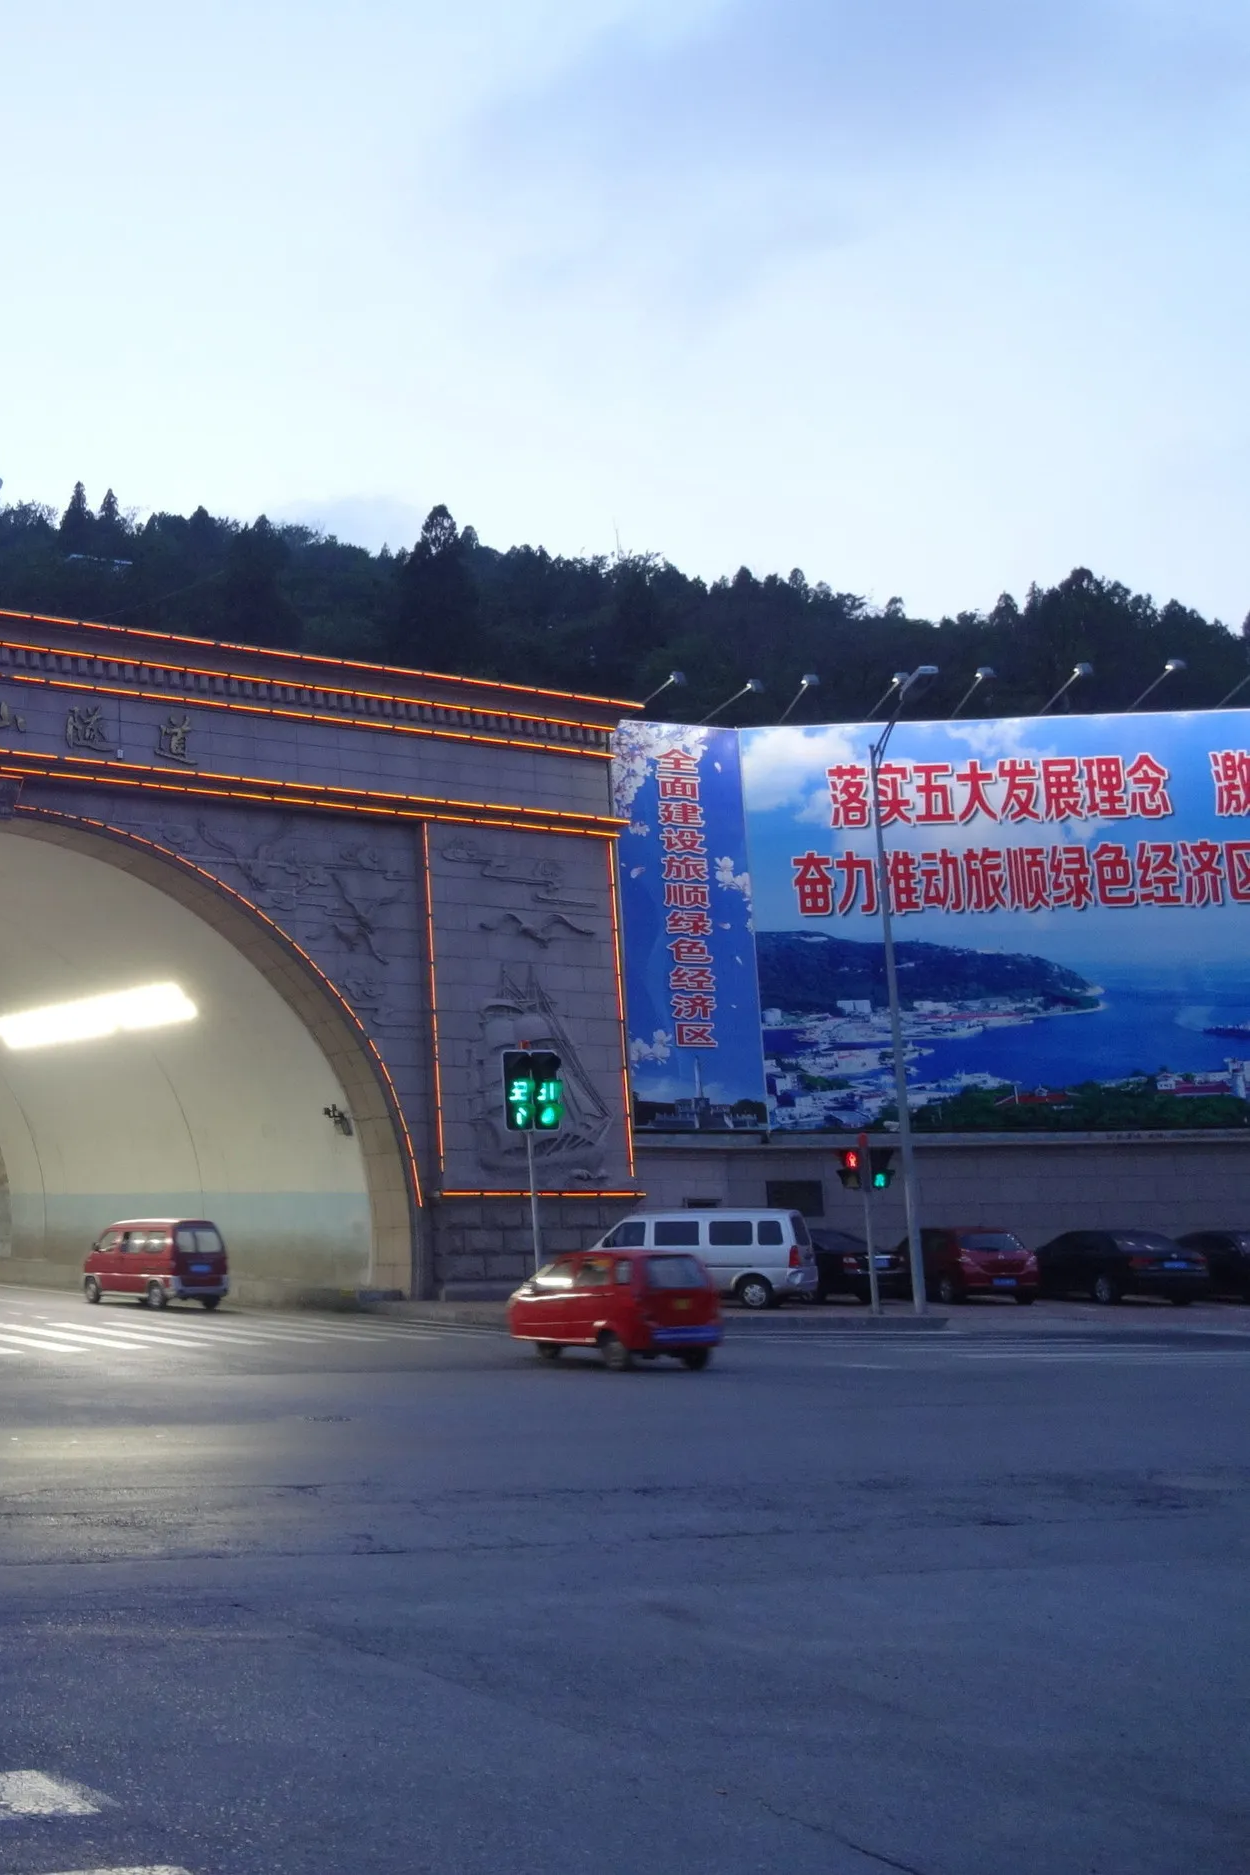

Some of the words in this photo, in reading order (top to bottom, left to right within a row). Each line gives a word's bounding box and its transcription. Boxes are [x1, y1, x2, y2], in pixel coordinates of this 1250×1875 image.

[827, 752, 1173, 828] 落实五大发展理念
[655, 748, 718, 1048] 全面建设旅顺绿色经济区
